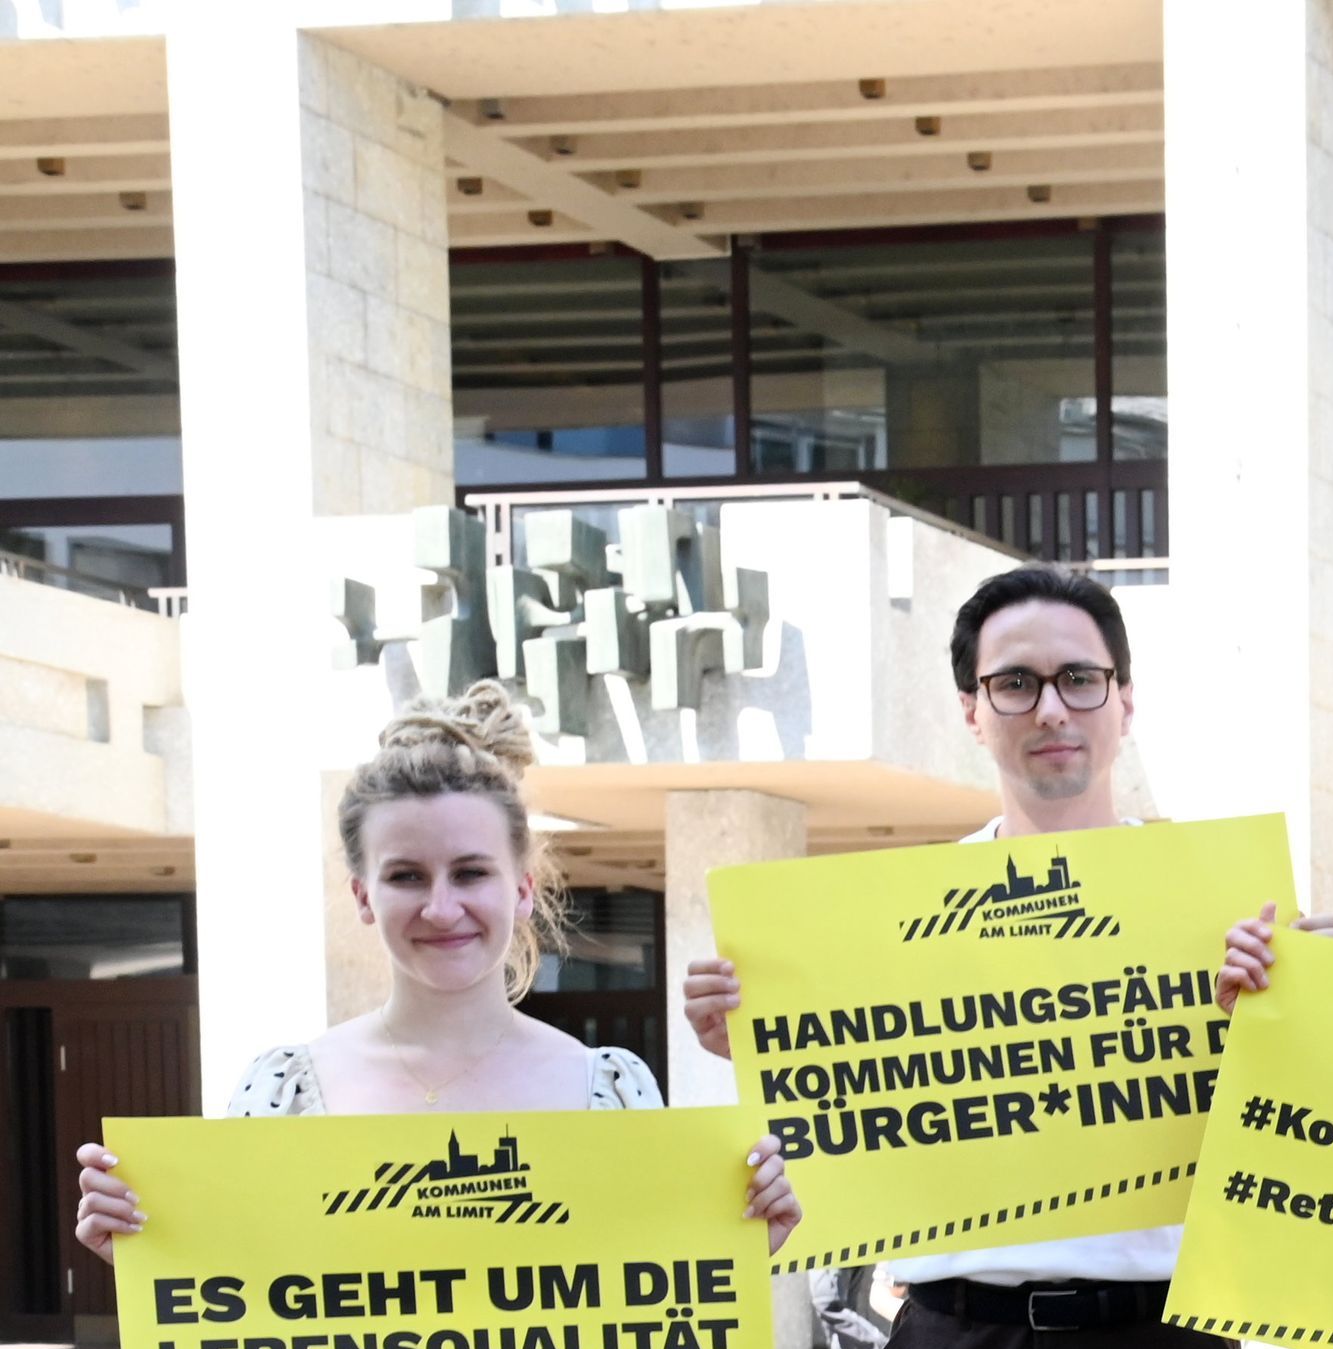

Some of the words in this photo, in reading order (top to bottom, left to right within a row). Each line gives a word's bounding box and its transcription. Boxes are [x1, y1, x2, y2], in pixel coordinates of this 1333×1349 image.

[982, 893, 1079, 921] KOMMUNEN
[979, 926, 1005, 938] AM
[1009, 924, 1052, 937] LIMIT
[752, 965, 1219, 1054] HANDLUNGSFÄHI
[760, 1036, 1076, 1105] KOMMUNEN
[1089, 1017, 1194, 1068] FÜR
[416, 1176, 527, 1200] KOMMUNEN
[411, 1205, 441, 1218] AM
[446, 1206, 495, 1219] LIMIT
[153, 1276, 247, 1325] ES
[268, 1268, 467, 1320] GEHT
[487, 1263, 601, 1312] UM
[623, 1258, 737, 1307] DIE
